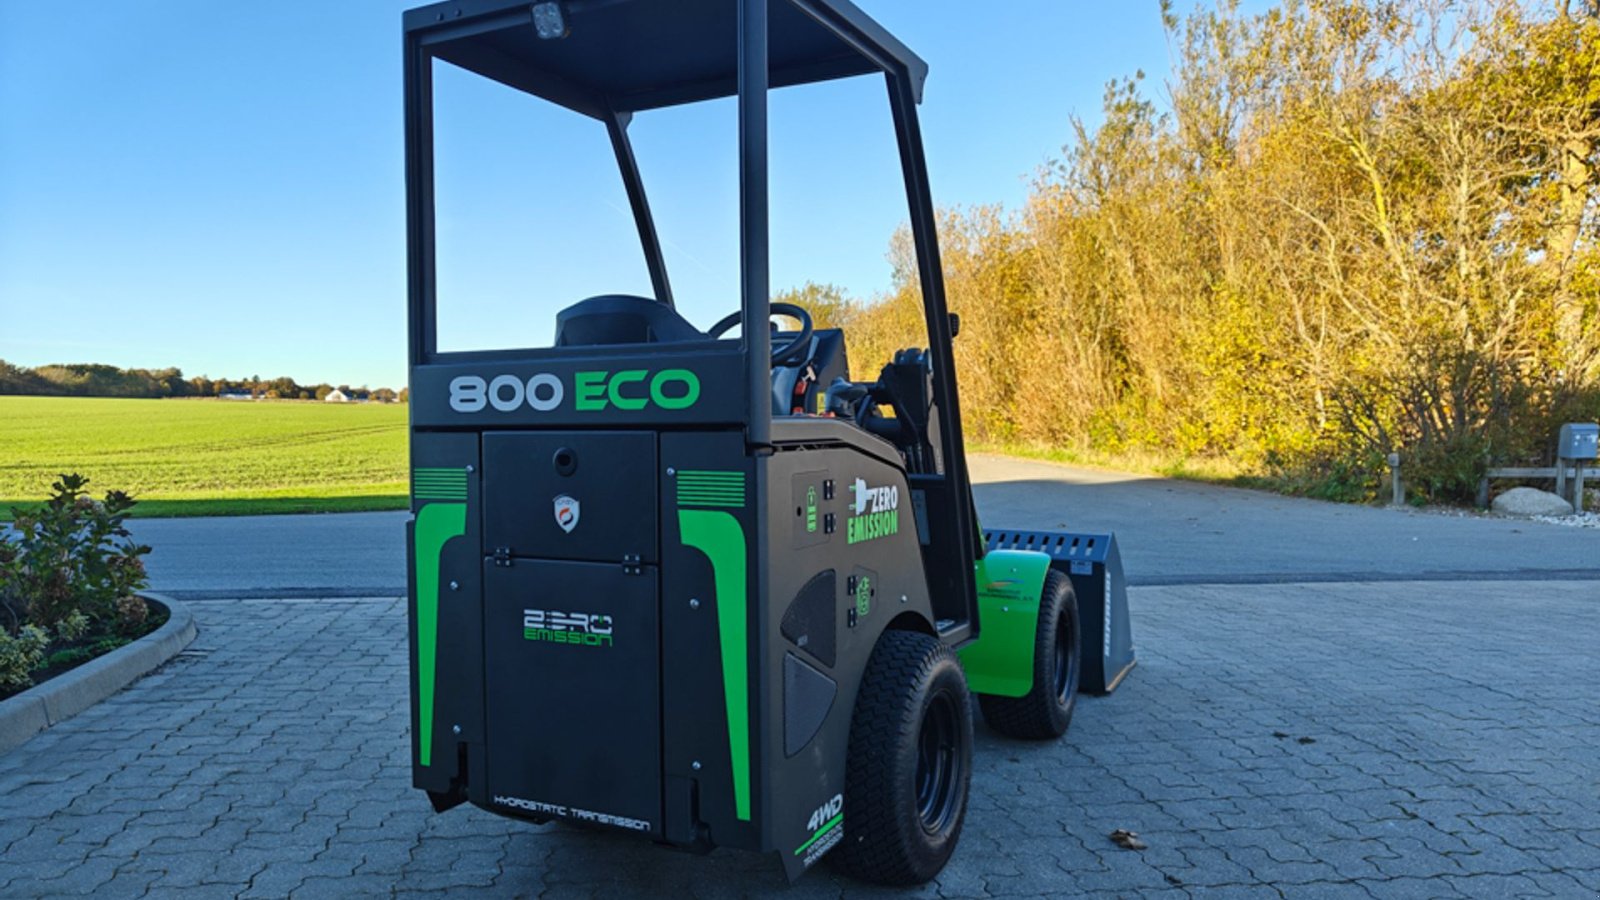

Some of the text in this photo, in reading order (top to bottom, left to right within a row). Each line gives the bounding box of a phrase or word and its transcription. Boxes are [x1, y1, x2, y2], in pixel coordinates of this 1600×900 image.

[449, 369, 700, 412] 800 ECO
[870, 485, 898, 512] ZERO
[848, 510, 898, 544] EMISSION
[524, 609, 612, 634] ZERO
[807, 793, 844, 831] 4WD
